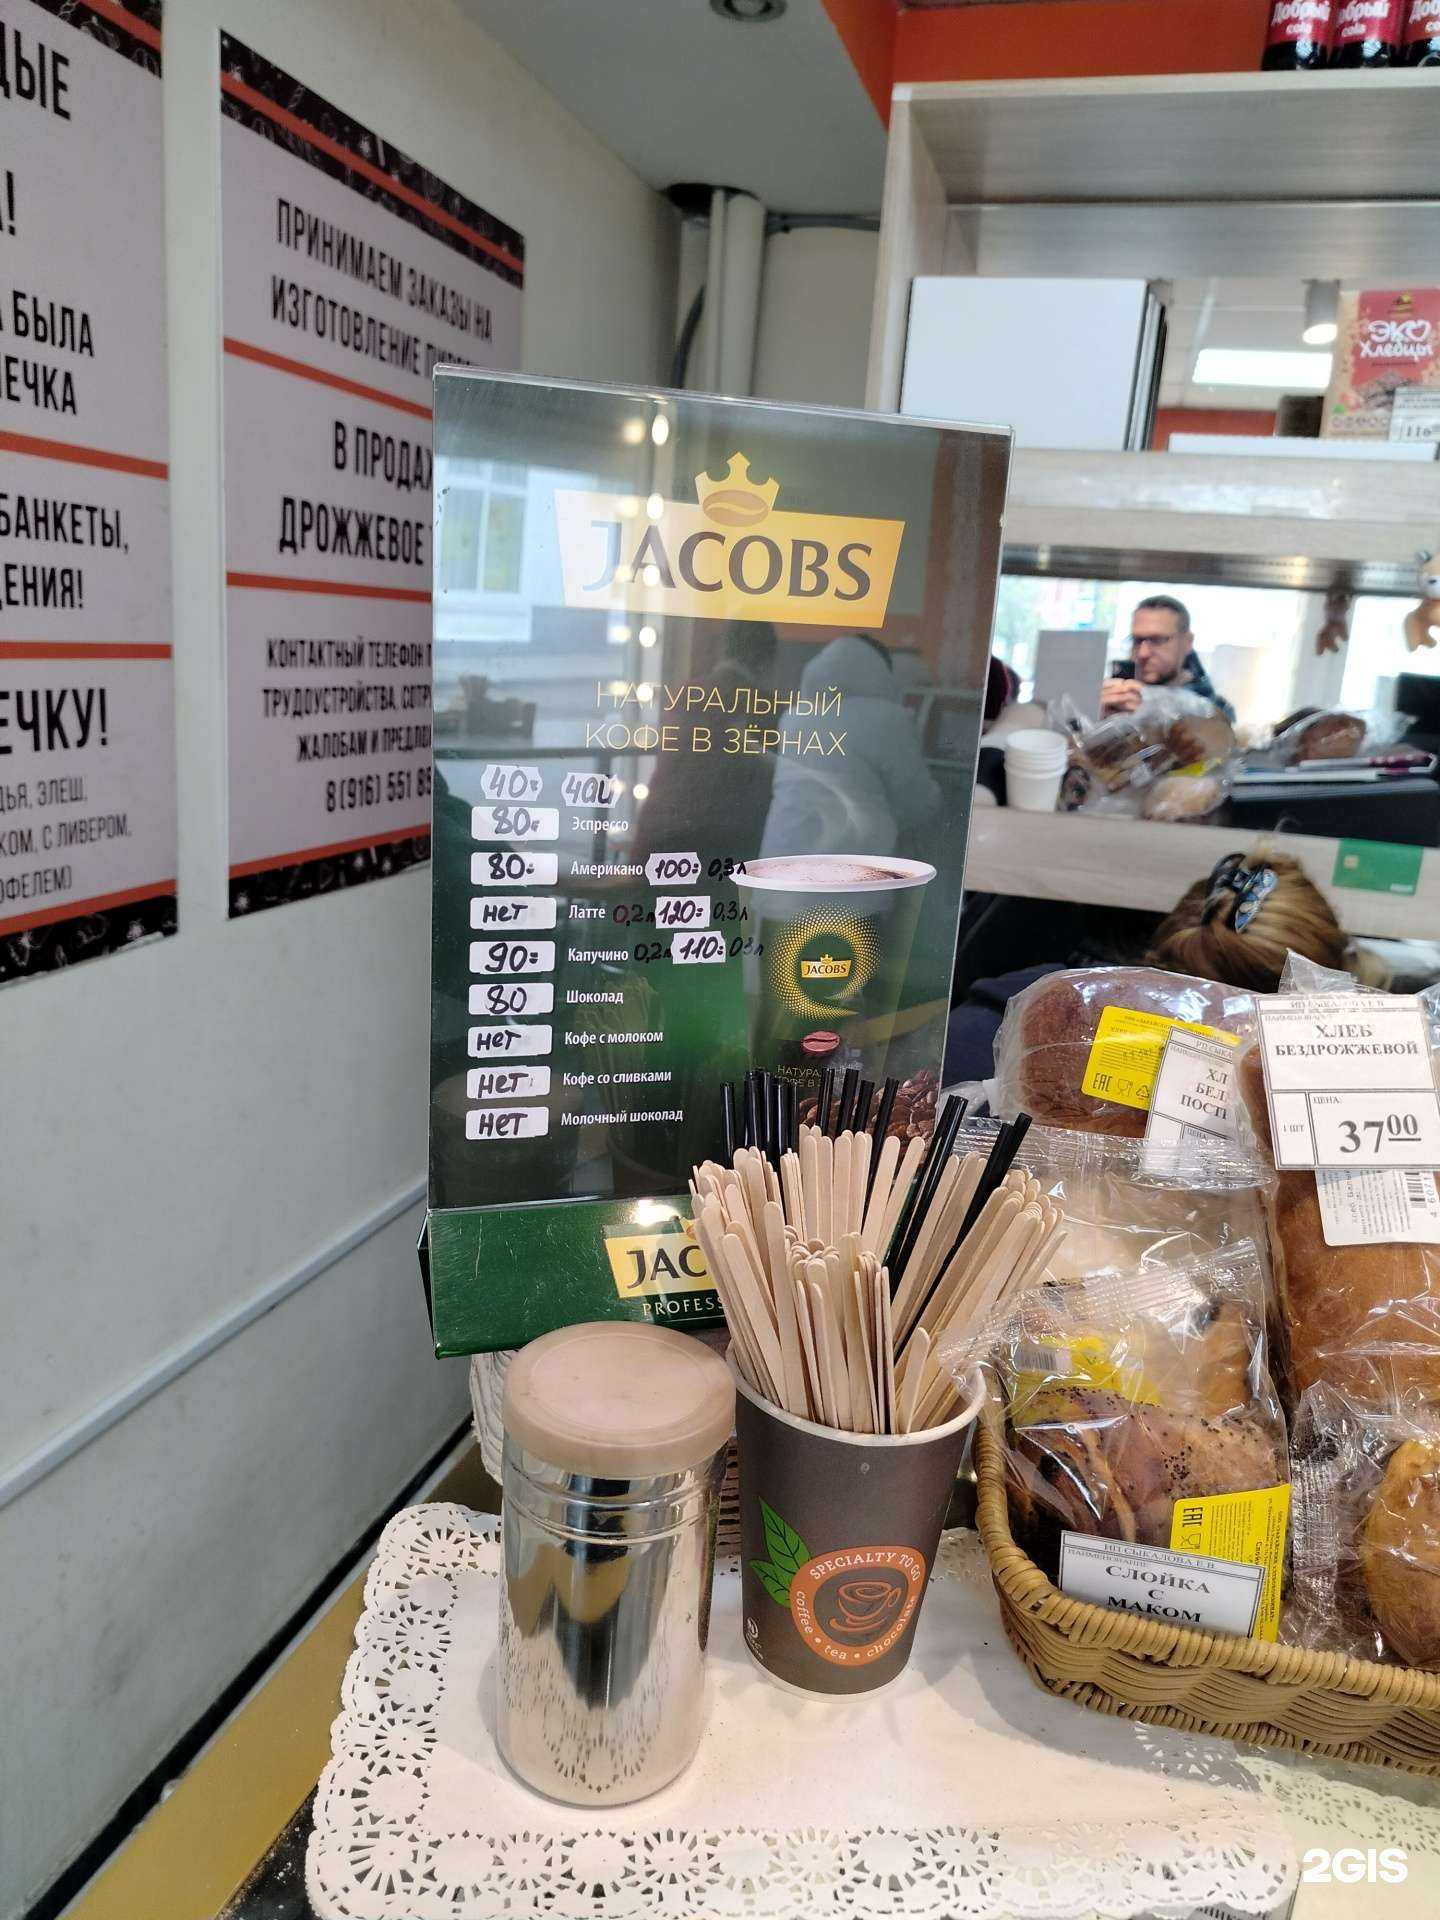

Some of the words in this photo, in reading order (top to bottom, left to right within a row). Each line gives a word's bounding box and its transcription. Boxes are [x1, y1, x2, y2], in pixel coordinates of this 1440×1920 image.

[278, 198, 402, 298] ПРИНИМАЕМ
[408, 268, 471, 332] ЗАКАЗЫ
[474, 302, 492, 342] НА
[13, 290, 94, 357] БЫЛА
[272, 275, 421, 376] ИЗГОТОВЛЕНИЕ
[0, 355, 76, 415] ЕЧКА
[335, 421, 347, 469] В
[280, 497, 424, 565] ДРОЖЖЕВОЕ
[582, 521, 872, 601] JACOBS
[0, 564, 83, 609] ЕНИЯ!
[267, 635, 364, 668] КОНТАКТНЫЙ
[369, 642, 424, 668] ТЕЛЕФОН
[596, 682, 843, 718] НАТУРАЛЬНЫЙ
[297, 730, 368, 763] ЖАЛОБАМ
[371, 729, 378, 753] И
[382, 723, 432, 753] ПРЕДЛО
[585, 722, 680, 751] КОФЕ
[692, 729, 712, 753] В
[722, 725, 848, 757] ЗЁРНАХ
[387, 771, 412, 802] 551
[43, 825, 53, 850] С
[571, 816, 629, 834] Эспрессо
[570, 859, 643, 877] Американо
[569, 905, 606, 919] Латте
[568, 948, 629, 965] Капучино
[805, 964, 847, 975] JACOBS
[485, 985, 527, 1014] 80
[566, 990, 624, 1004] Шоколад
[565, 1032, 596, 1046] Кофе
[599, 1033, 605, 1043] с
[608, 1032, 663, 1043] молоком
[1316, 1024, 1374, 1039] ХЛЕБ
[1276, 1041, 1419, 1058] БЕЗДРОЖЖЕВОЙ
[563, 1073, 594, 1088] Кофе
[598, 1074, 610, 1084] со
[613, 1071, 672, 1084] сливками
[561, 1110, 627, 1126] Молочный
[629, 1109, 684, 1123] шоколад
[809, 1552, 896, 1579] SPECIALTY
[899, 1553, 913, 1568] TO
[1106, 1564, 1211, 1594] СЛОЙКА
[1148, 1588, 1164, 1600] С
[1108, 1595, 1201, 1623] МАКОМ
[796, 1591, 814, 1634] coffee
[824, 1644, 847, 1660] tea
